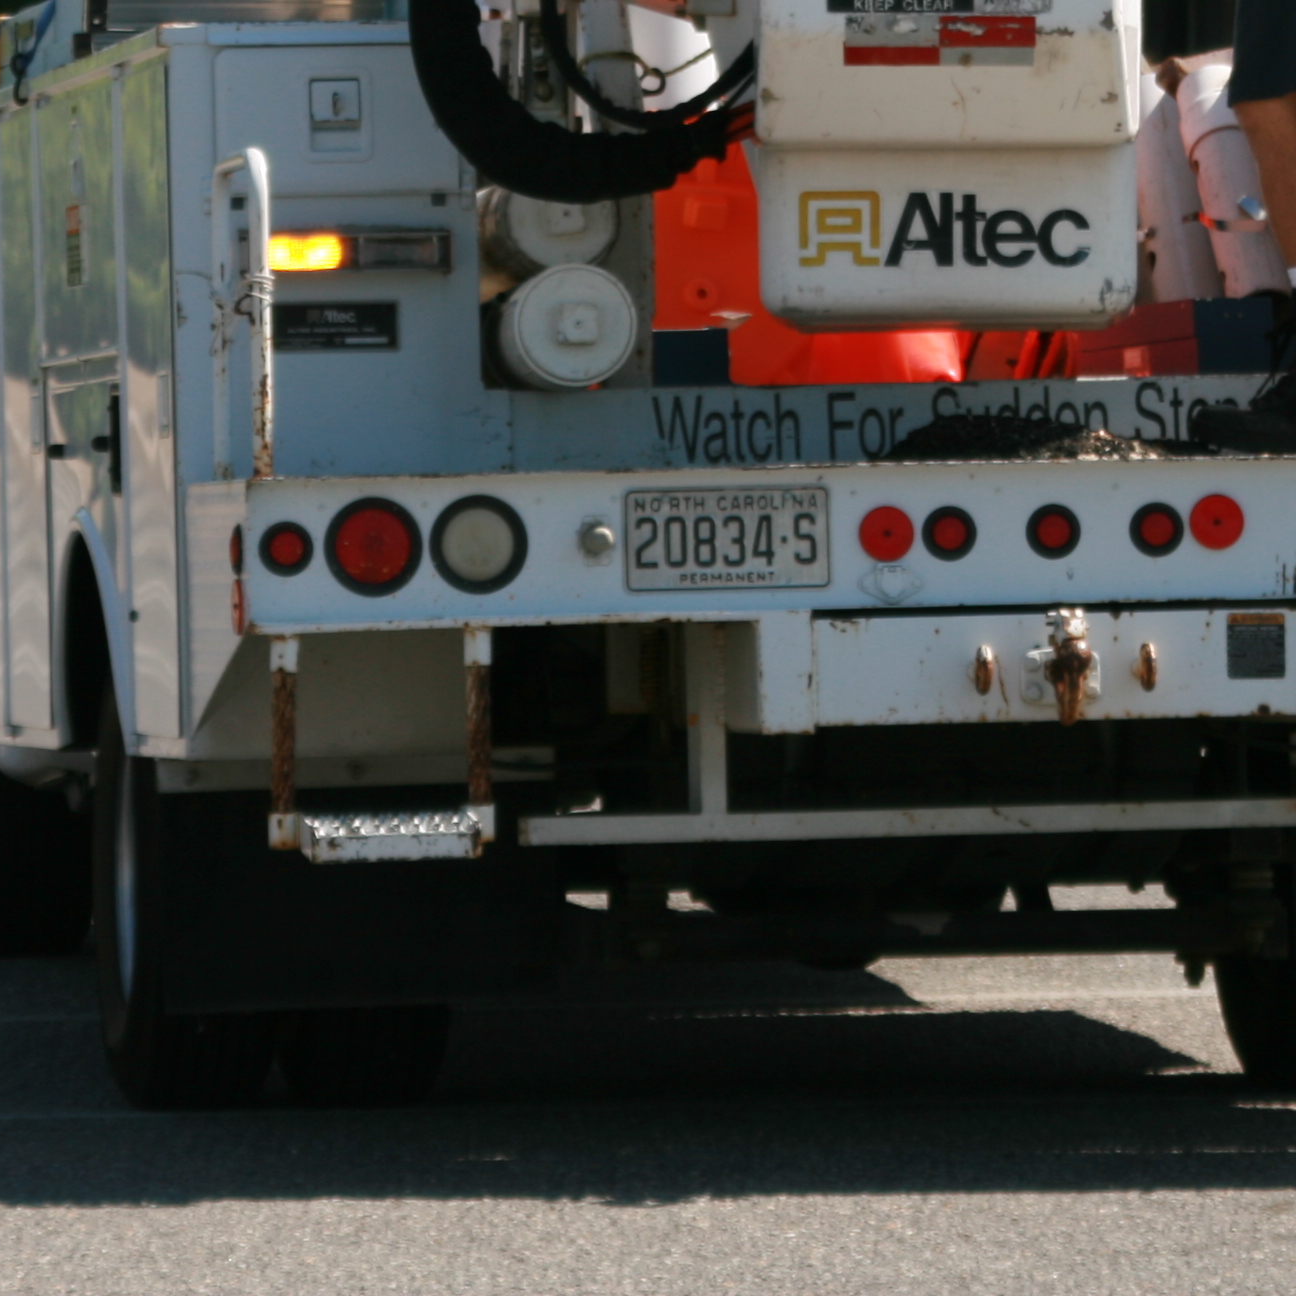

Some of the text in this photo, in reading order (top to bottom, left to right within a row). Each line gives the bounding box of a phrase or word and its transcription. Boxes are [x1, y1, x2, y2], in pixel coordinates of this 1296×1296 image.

[884, 191, 1091, 268] Altec
[651, 393, 801, 464] Watch
[827, 391, 904, 461] For
[634, 493, 818, 513] NORTH CAROLINA
[679, 572, 775, 584] PERMANENT
